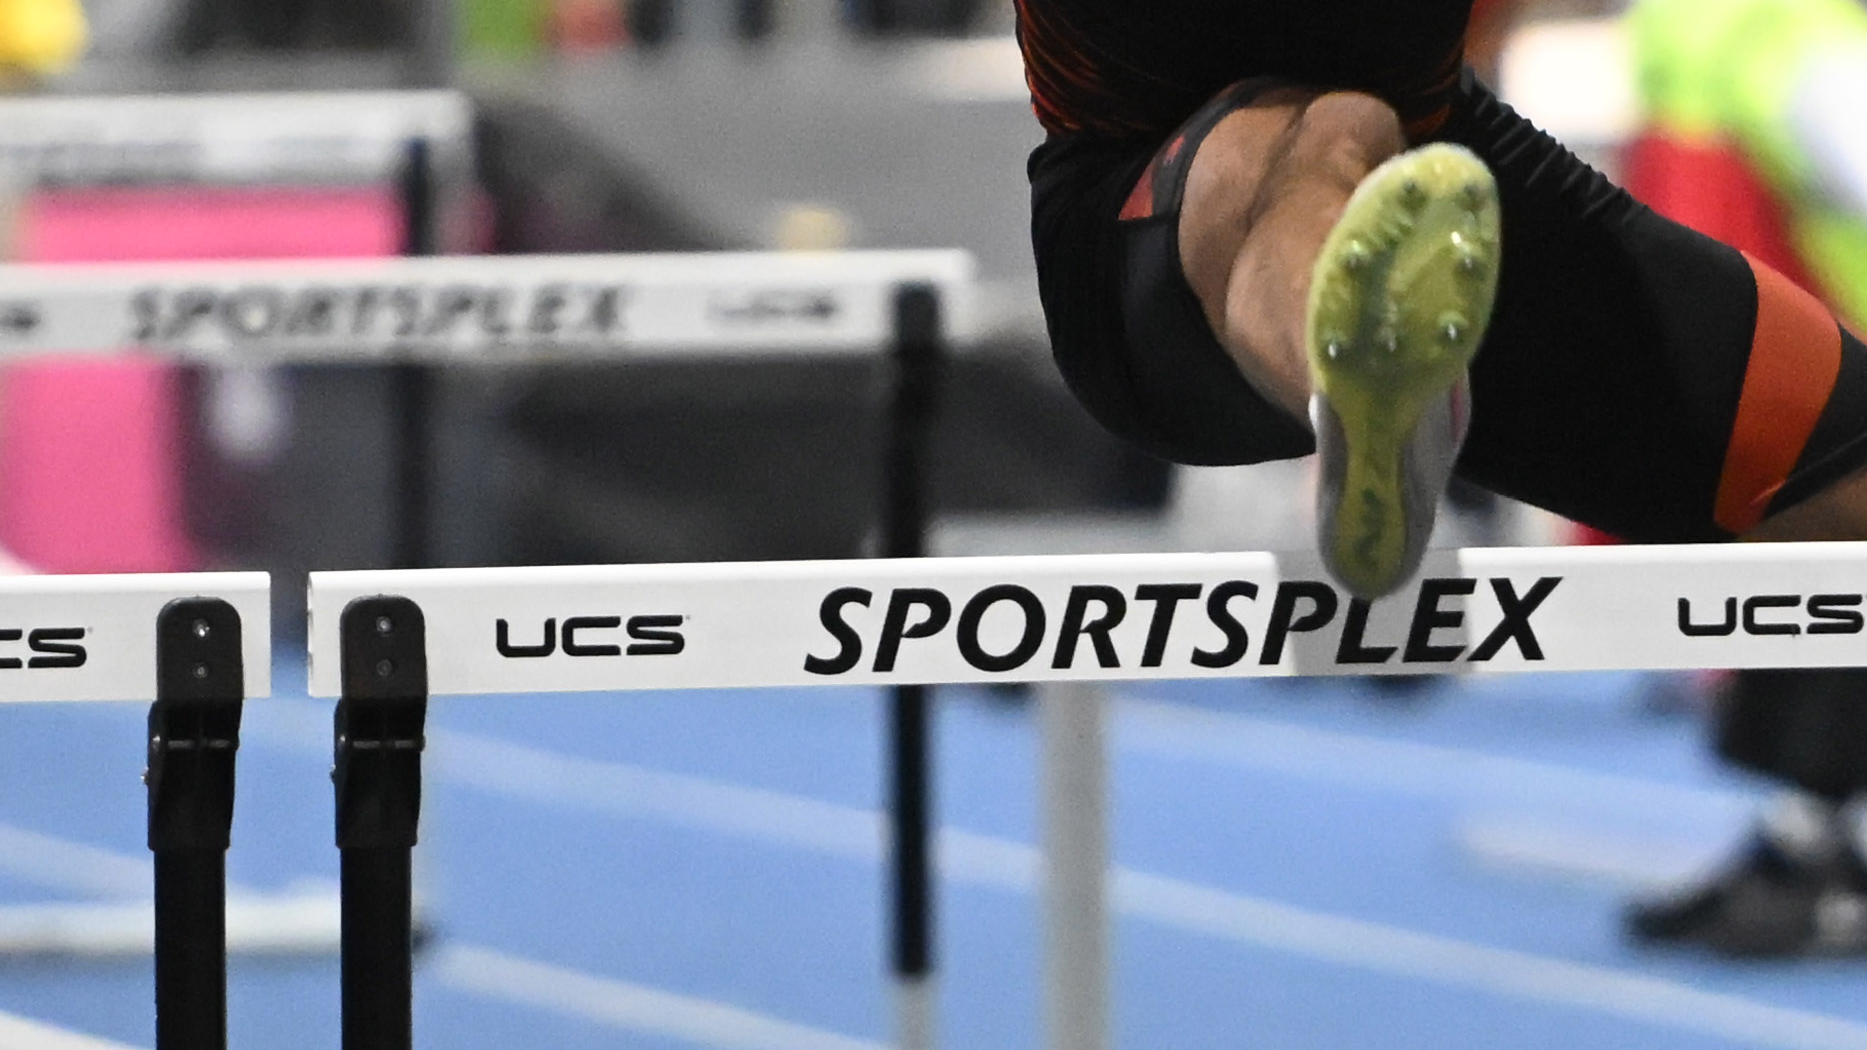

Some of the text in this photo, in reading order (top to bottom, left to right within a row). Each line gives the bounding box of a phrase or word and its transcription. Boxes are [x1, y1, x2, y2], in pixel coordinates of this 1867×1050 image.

[496, 576, 1865, 676] UCS SPORTSPLEX UCS
